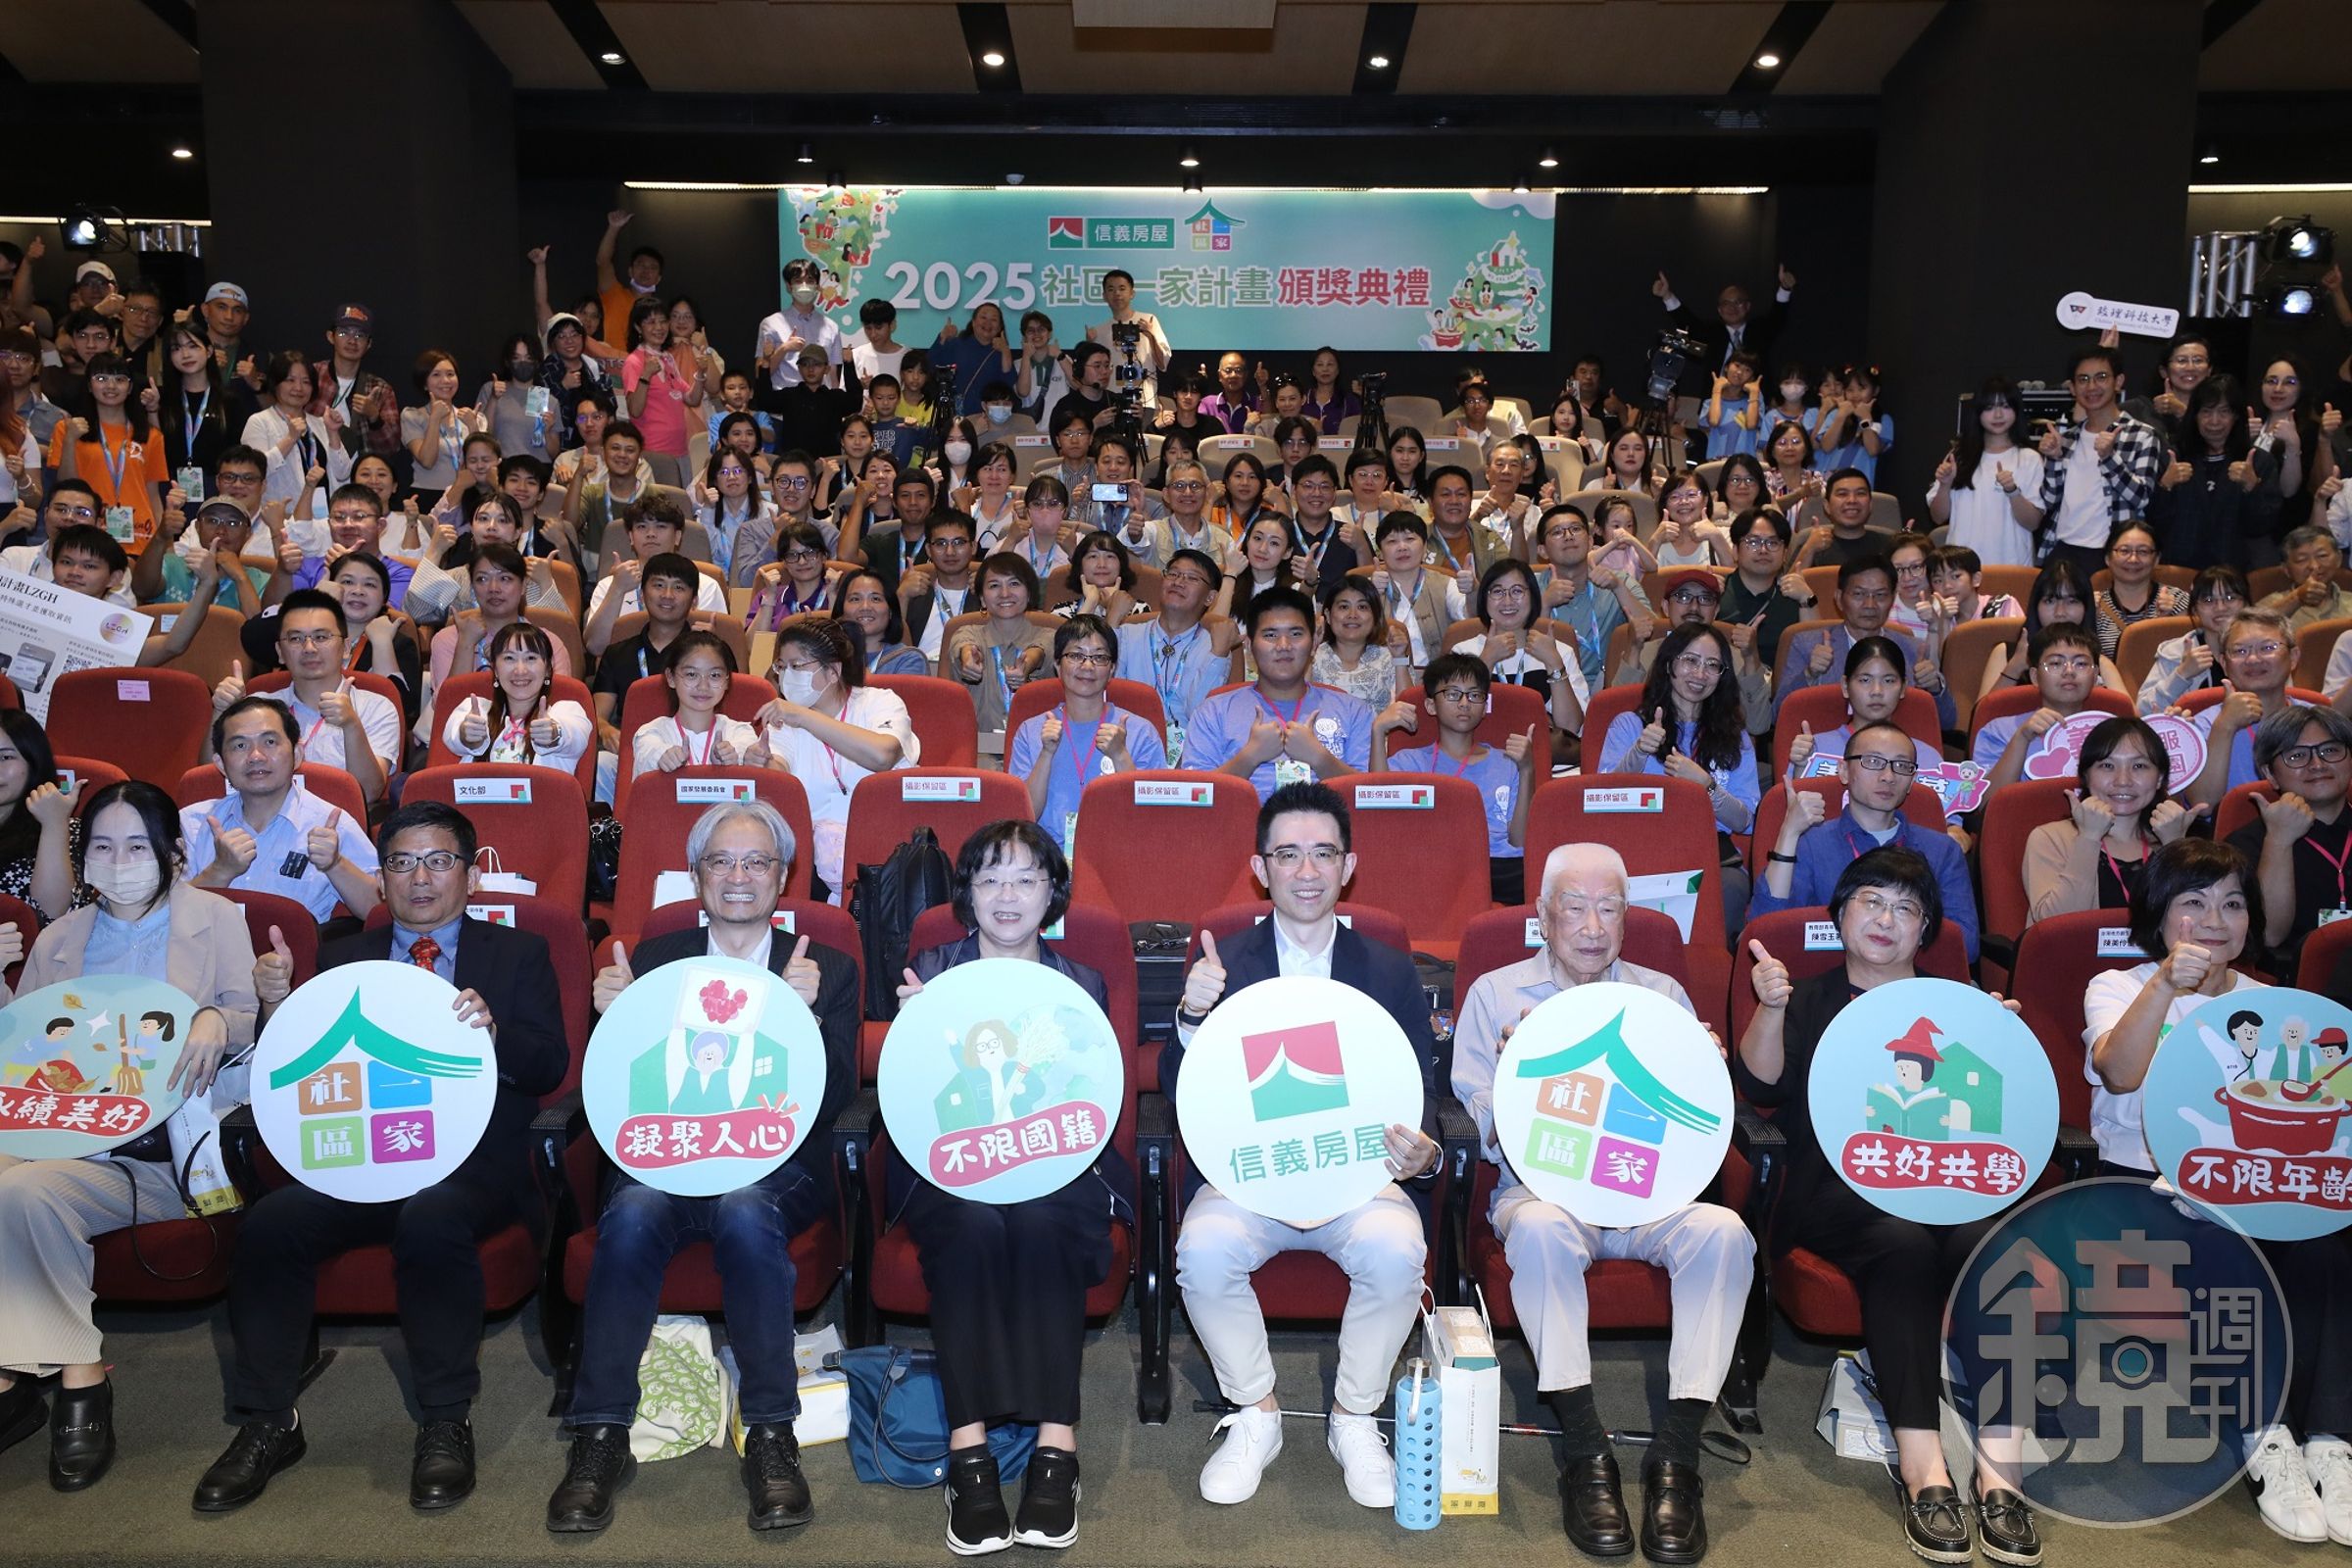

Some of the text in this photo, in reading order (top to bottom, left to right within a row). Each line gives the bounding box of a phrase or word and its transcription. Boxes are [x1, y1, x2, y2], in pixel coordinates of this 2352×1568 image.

[1095, 224, 1167, 243] 信義房屋
[885, 261, 1036, 310] 2025
[1277, 266, 1431, 307] 頒獎典禮
[459, 785, 486, 796] 文化部
[905, 782, 948, 791] 攝影保留區
[1138, 786, 1180, 796] 攝影保留區
[1358, 790, 1400, 800] 攝影保留區
[1586, 793, 1629, 803] 攝影保留區
[623, 1120, 787, 1158] 凝聚人心
[940, 1108, 1097, 1173] 不限國籍
[1229, 1123, 1392, 1184] 信義房屋
[1850, 1139, 2023, 1194] 共好共學
